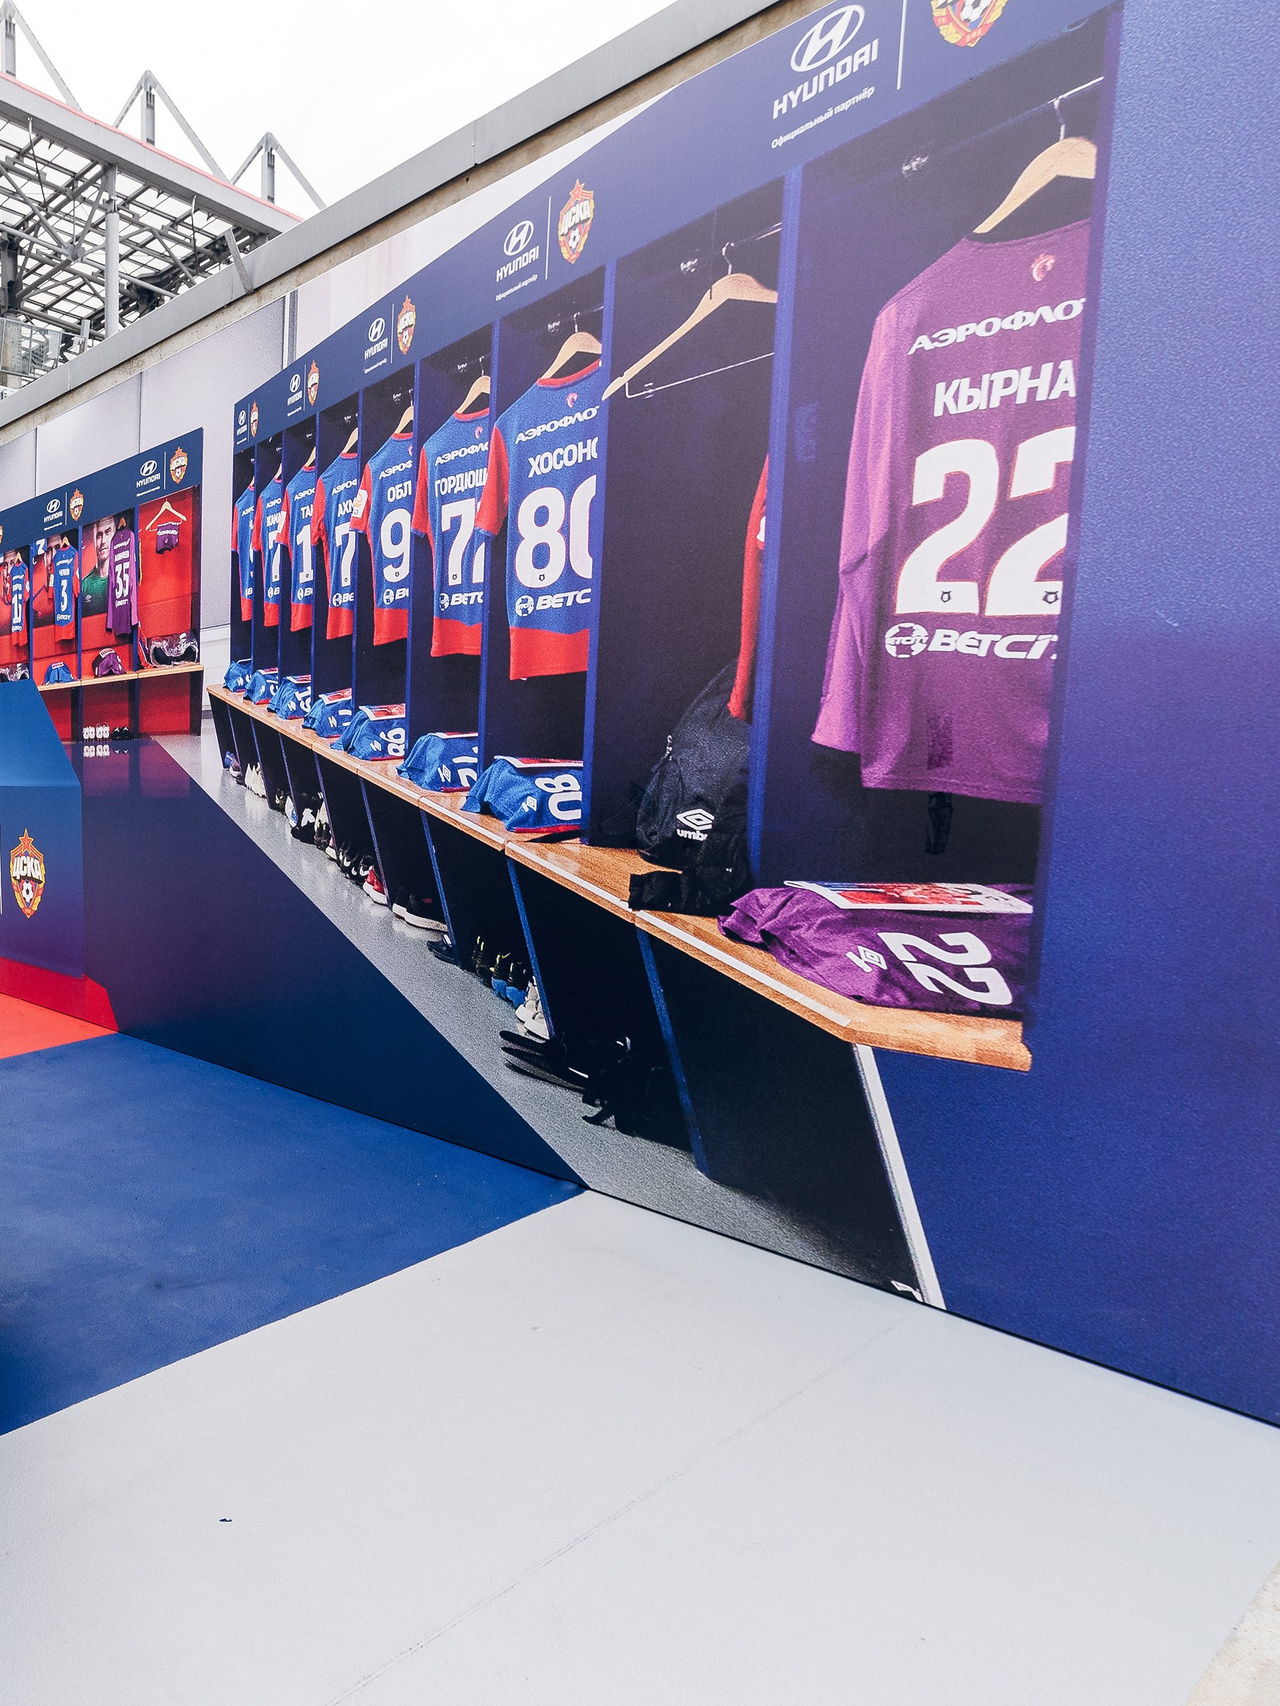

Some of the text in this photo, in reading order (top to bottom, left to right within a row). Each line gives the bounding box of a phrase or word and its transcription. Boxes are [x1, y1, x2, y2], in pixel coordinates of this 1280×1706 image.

[773, 38, 879, 120] HYUNDAI
[771, 86, 876, 149] Официальный партнёр
[560, 199, 591, 236] ЦСКА
[496, 245, 540, 283] HYUNDAI
[907, 298, 1087, 355] АЭРОФЛО
[515, 405, 600, 444] АЭРОФЛО
[895, 425, 1077, 617] 22
[60, 579, 68, 612] 3
[115, 561, 131, 600] 35
[13, 855, 43, 881] ЦСКА
[877, 931, 1013, 1006] 22
